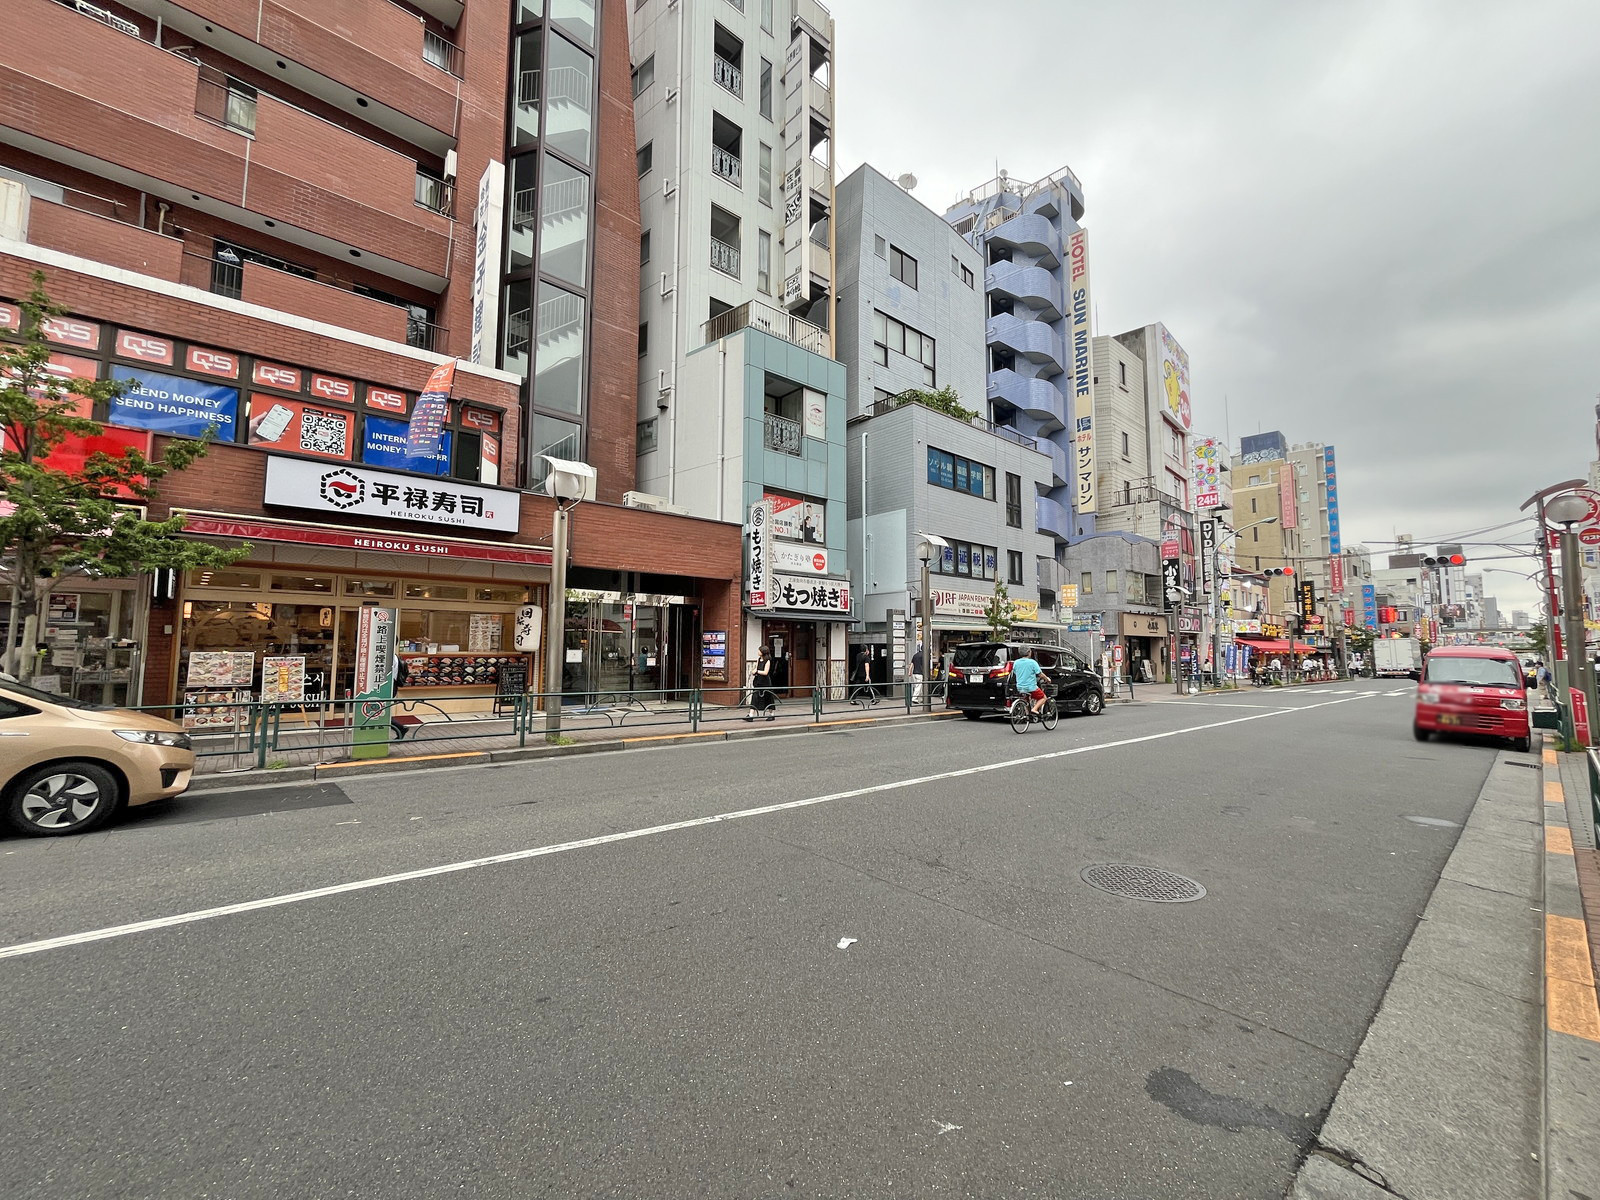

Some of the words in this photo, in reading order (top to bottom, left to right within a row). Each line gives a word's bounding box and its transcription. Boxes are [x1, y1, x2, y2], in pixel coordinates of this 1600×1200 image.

[1070, 232, 1085, 283] HOTEL
[1072, 287, 1087, 325] SUN
[123, 335, 167, 357] QS
[192, 350, 232, 371] QS
[1075, 331, 1089, 398] MARINE
[260, 365, 296, 385] QS
[316, 377, 350, 397] QS
[172, 393, 221, 409] MONEY
[371, 390, 402, 409] QS
[116, 397, 154, 411] SEND
[158, 403, 233, 424] HAPPINESS
[467, 410, 493, 427] QS
[1077, 432, 1092, 443] ホテル
[366, 442, 402, 455] MONEY
[482, 439, 497, 457] QS
[1077, 446, 1092, 506] サンマリン
[371, 482, 485, 518] 平禄寿司
[1197, 494, 1218, 506] 24H
[390, 511, 434, 521] HEIROKU
[438, 516, 465, 525] SUSHI
[354, 538, 410, 551] HEIROKU
[414, 544, 449, 554] SUSHI
[751, 528, 762, 590] もつ焼き
[783, 583, 840, 609] もつ焼き
[940, 591, 957, 607] JRF
[958, 594, 975, 602] JAPAN
